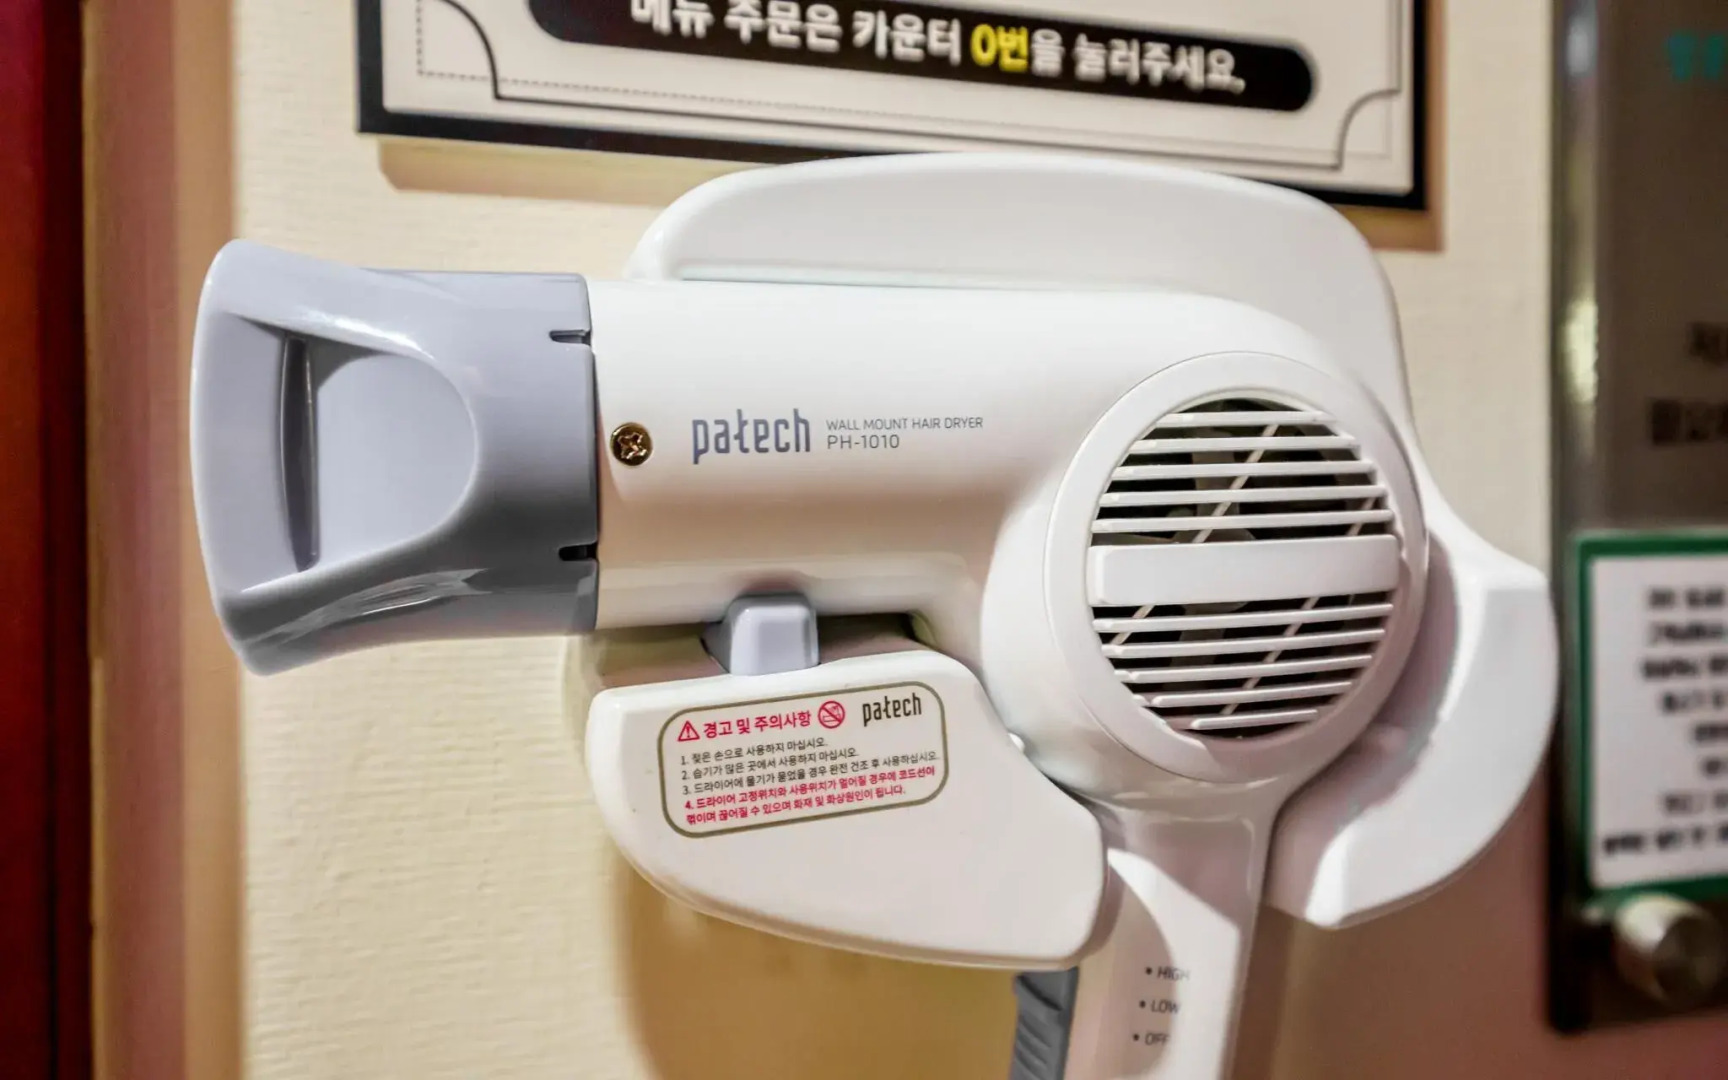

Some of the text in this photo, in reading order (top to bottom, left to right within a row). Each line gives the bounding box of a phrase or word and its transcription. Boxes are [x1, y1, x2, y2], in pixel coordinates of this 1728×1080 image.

[631, 0, 715, 38] 메뉴
[723, 0, 843, 53] 주문은
[852, 10, 961, 66] 카운터
[970, 23, 1065, 78] 0번을
[692, 408, 811, 465] patech
[826, 417, 984, 430] WALL MOUNT HAIR DRYER
[827, 434, 900, 449] PH-1010
[703, 710, 811, 739] 경고 및 주의사항
[862, 692, 922, 727] patech
[681, 737, 828, 765] 1. 젖은 손으로 사용하지 마십시오.
[682, 747, 858, 780] 2. 습기가 많은 곳에서 사용하지 마십시오.
[682, 786, 691, 795] 3.
[694, 777, 743, 793] 드라이어에
[747, 773, 775, 787] 물기가
[778, 769, 805, 782] 묻었을
[809, 766, 827, 777] 경우
[830, 763, 848, 775] 완전
[851, 760, 869, 772] 건조
[871, 759, 879, 768] 후
[685, 765, 935, 810] 4. 드라이어 고정위치와 사용위치가 멀어질 경우에 코드선이
[719, 807, 748, 821] 끊어질
[751, 806, 760, 815] 수
[763, 800, 791, 814] 있으며
[794, 798, 812, 809] 화재
[815, 796, 824, 807] 및
[826, 789, 873, 804] 화상원인이
[875, 785, 905, 798] 됩니다.
[1156, 966, 1190, 981] HIGH
[1151, 999, 1179, 1013] LOW
